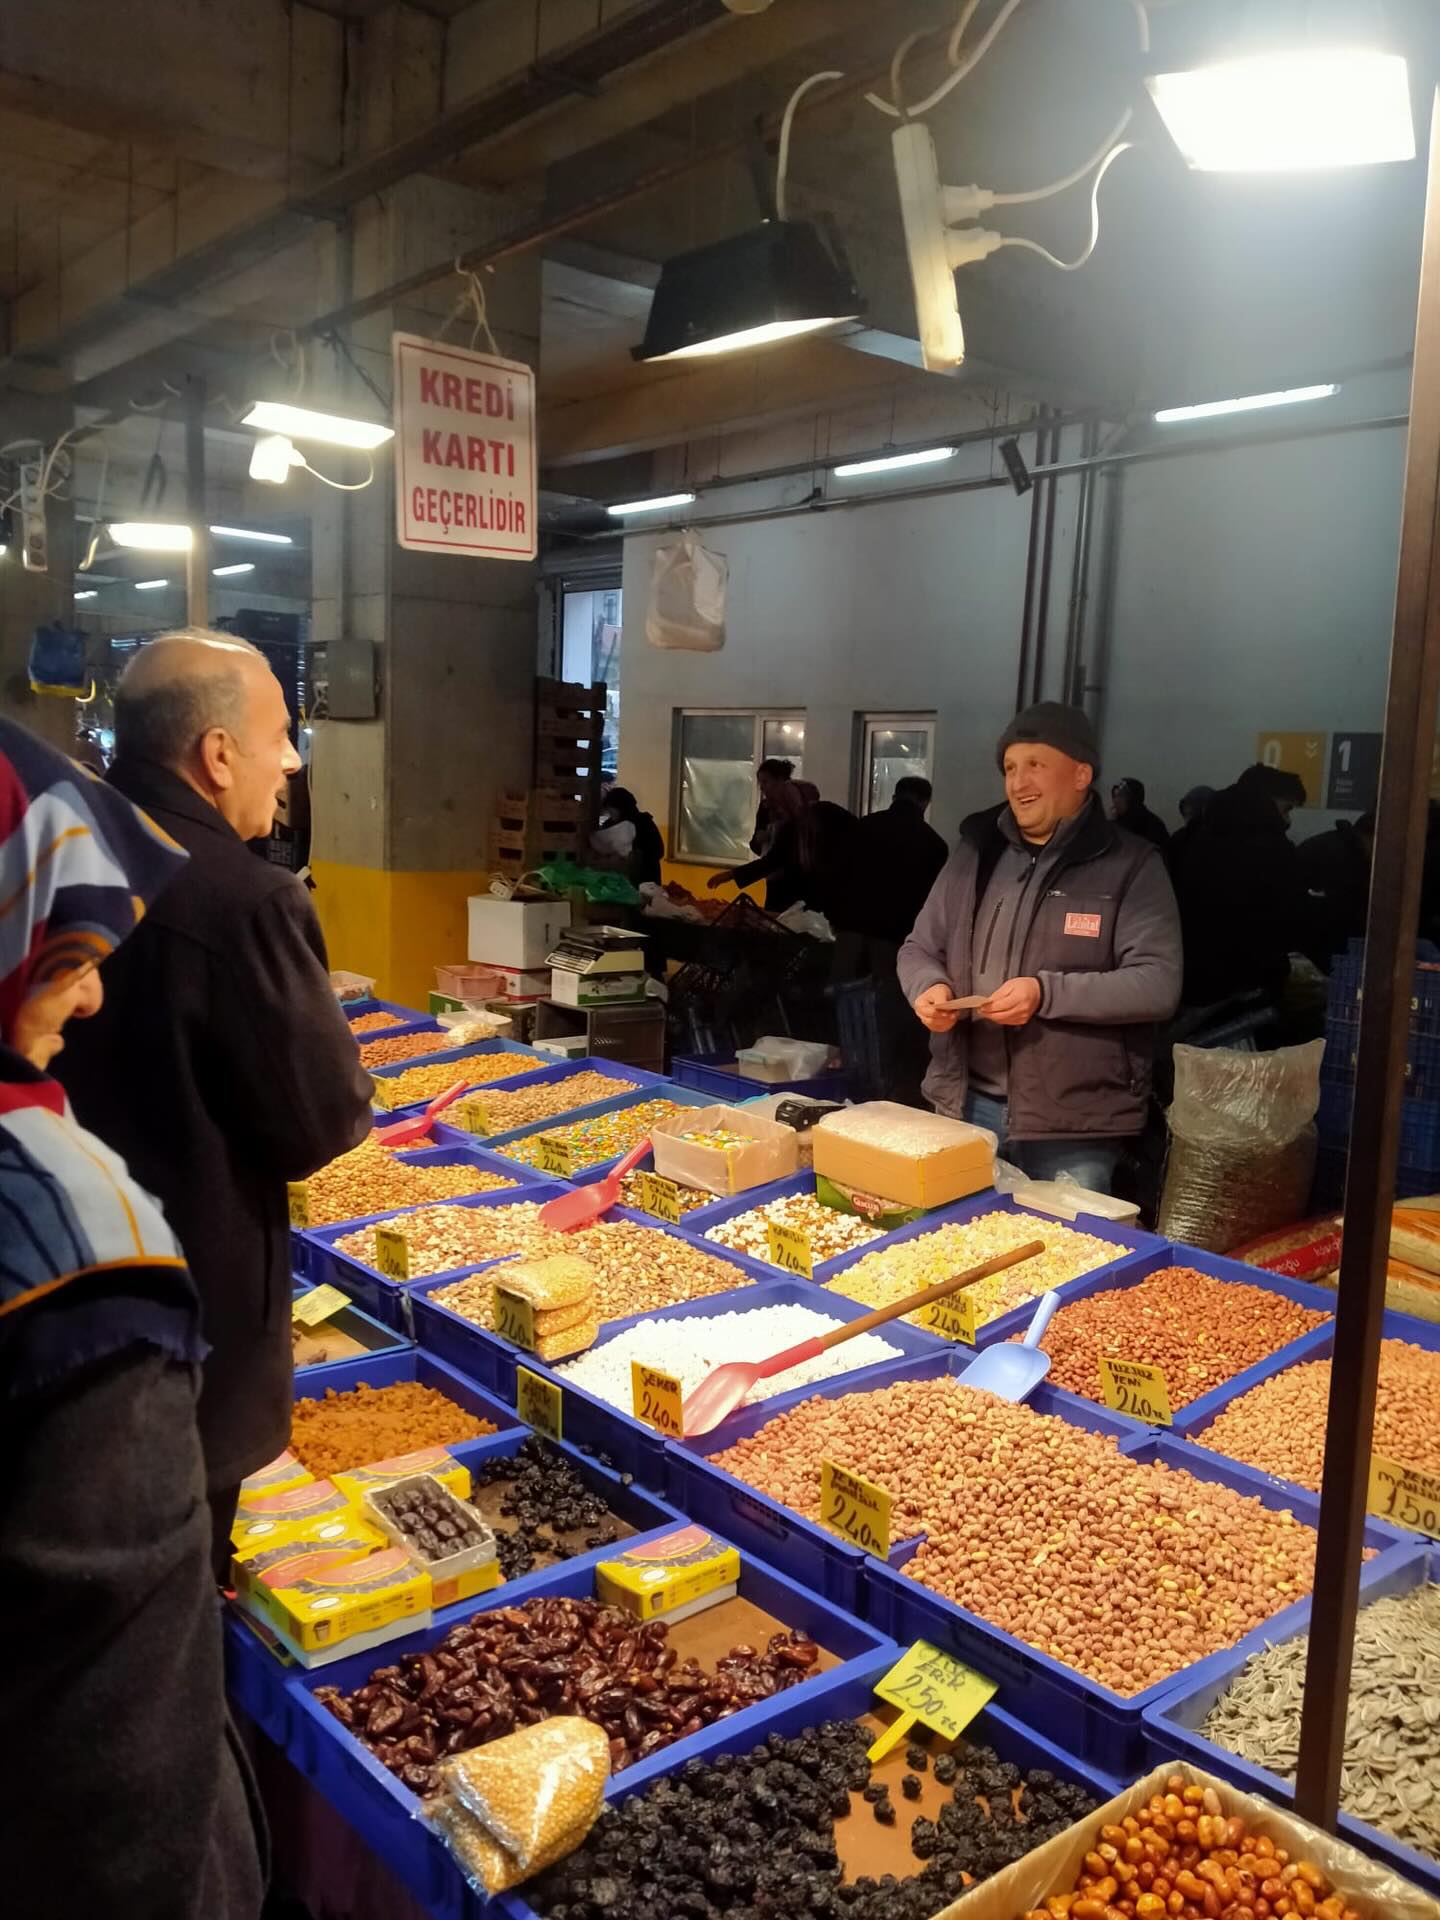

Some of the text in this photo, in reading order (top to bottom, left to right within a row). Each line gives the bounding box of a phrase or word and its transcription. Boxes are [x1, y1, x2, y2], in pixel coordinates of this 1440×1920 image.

[419, 366, 514, 422] KREDİ
[421, 427, 515, 478] KARTI
[411, 485, 526, 535] GEÇERLİDİR
